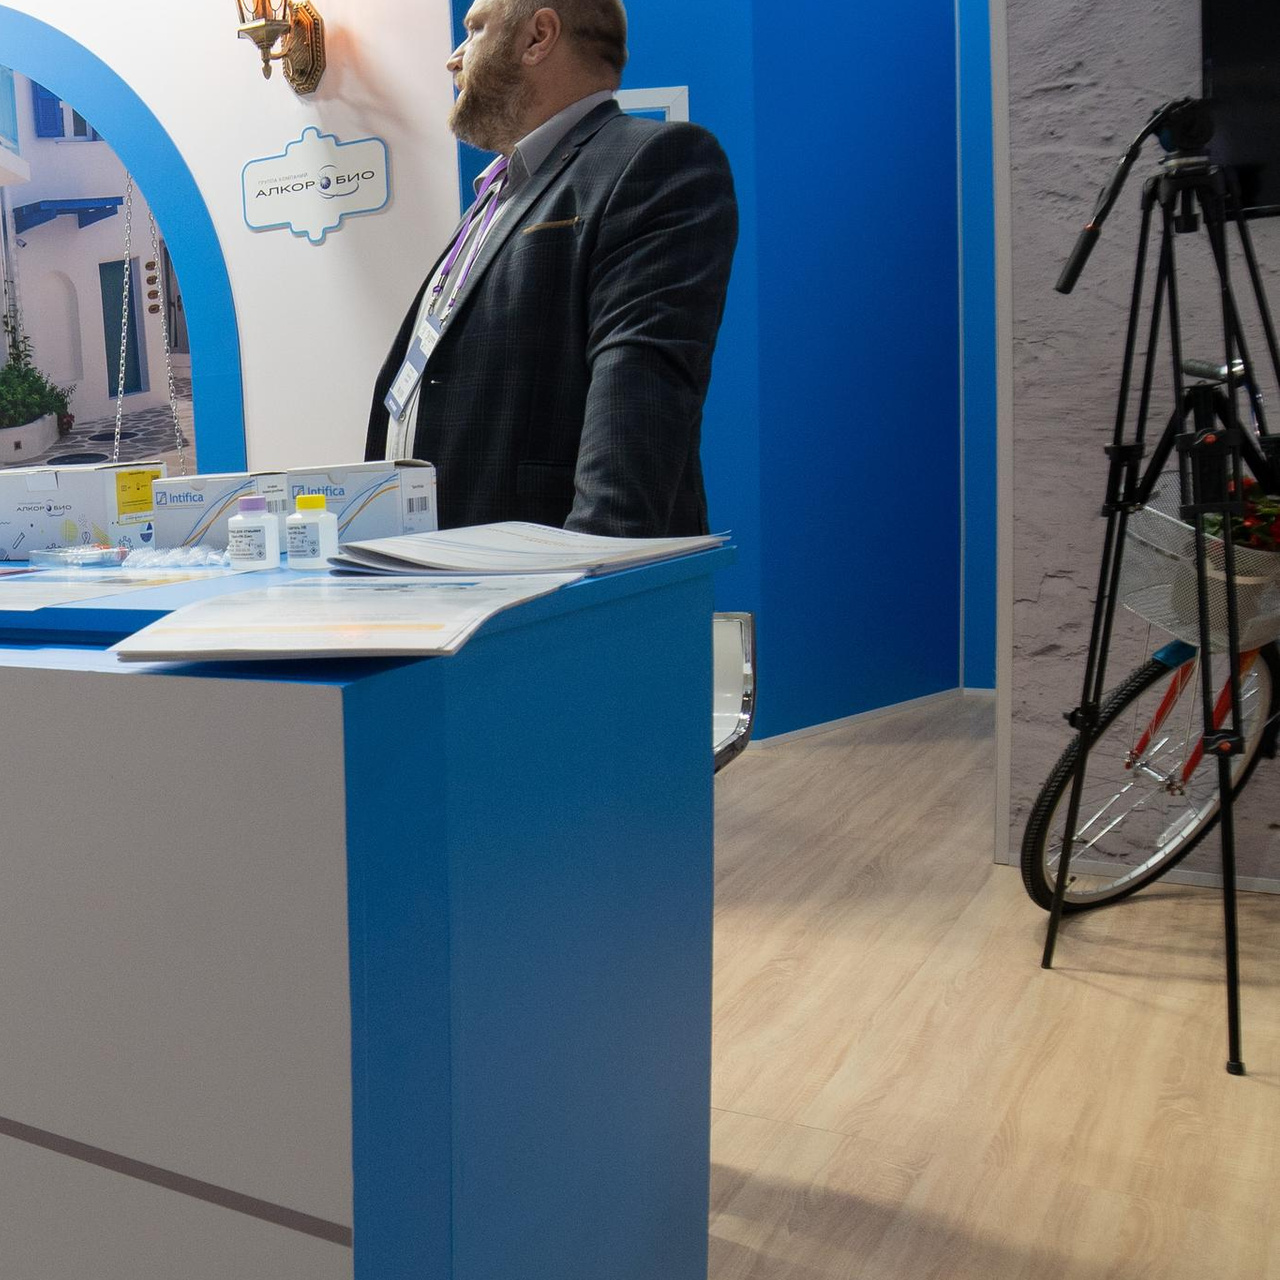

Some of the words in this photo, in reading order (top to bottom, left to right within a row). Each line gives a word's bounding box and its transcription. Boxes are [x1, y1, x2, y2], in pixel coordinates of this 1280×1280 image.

[255, 180, 316, 199] АЛКОР
[335, 170, 375, 186] БИО
[169, 491, 204, 503] Intifica
[53, 504, 72, 512] БИО
